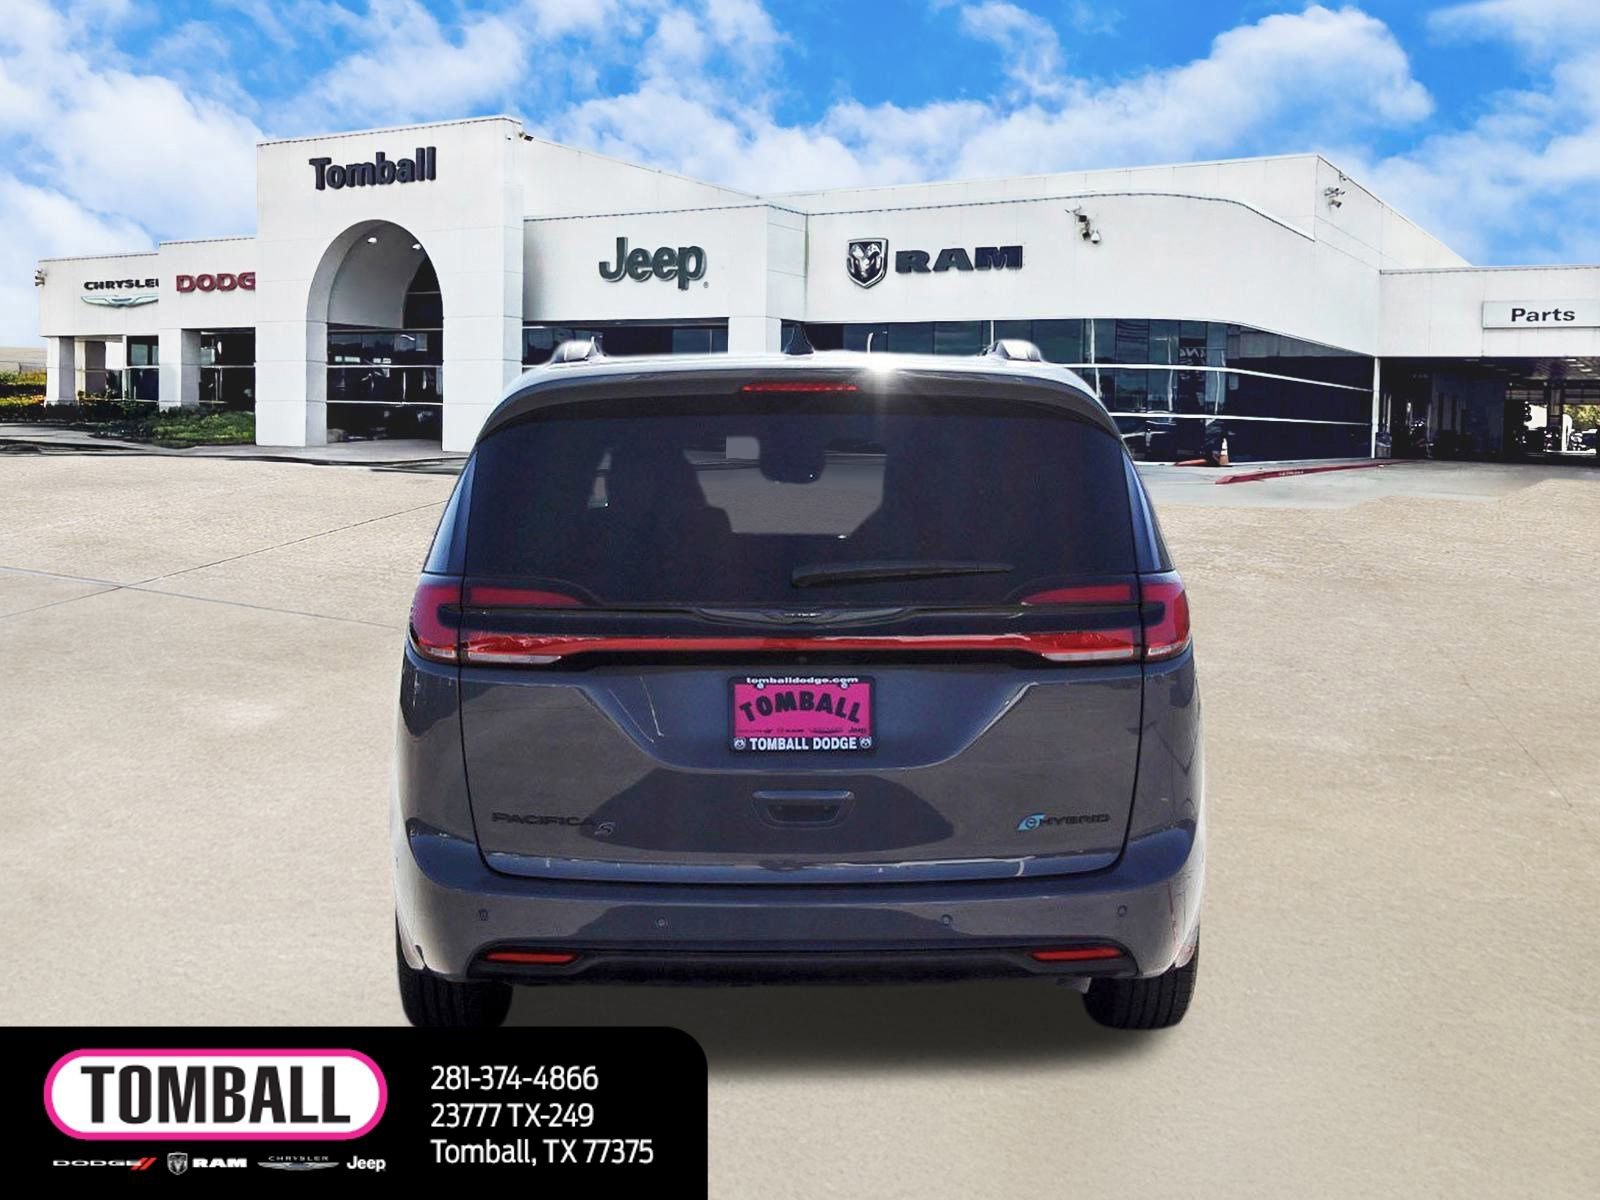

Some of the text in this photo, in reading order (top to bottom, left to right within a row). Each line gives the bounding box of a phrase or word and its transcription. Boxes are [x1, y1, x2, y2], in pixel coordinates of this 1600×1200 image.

[309, 146, 437, 191] Tomball
[599, 237, 707, 290] Jeep
[895, 245, 1024, 274] RAM
[84, 279, 159, 290] CHRYSLE
[1511, 307, 1576, 322] Parts
[747, 677, 859, 685] tomballdodge.com
[739, 691, 860, 723] TOMBALL
[750, 737, 857, 750] TOMBALL DODGE
[492, 812, 595, 825] PACIFICA
